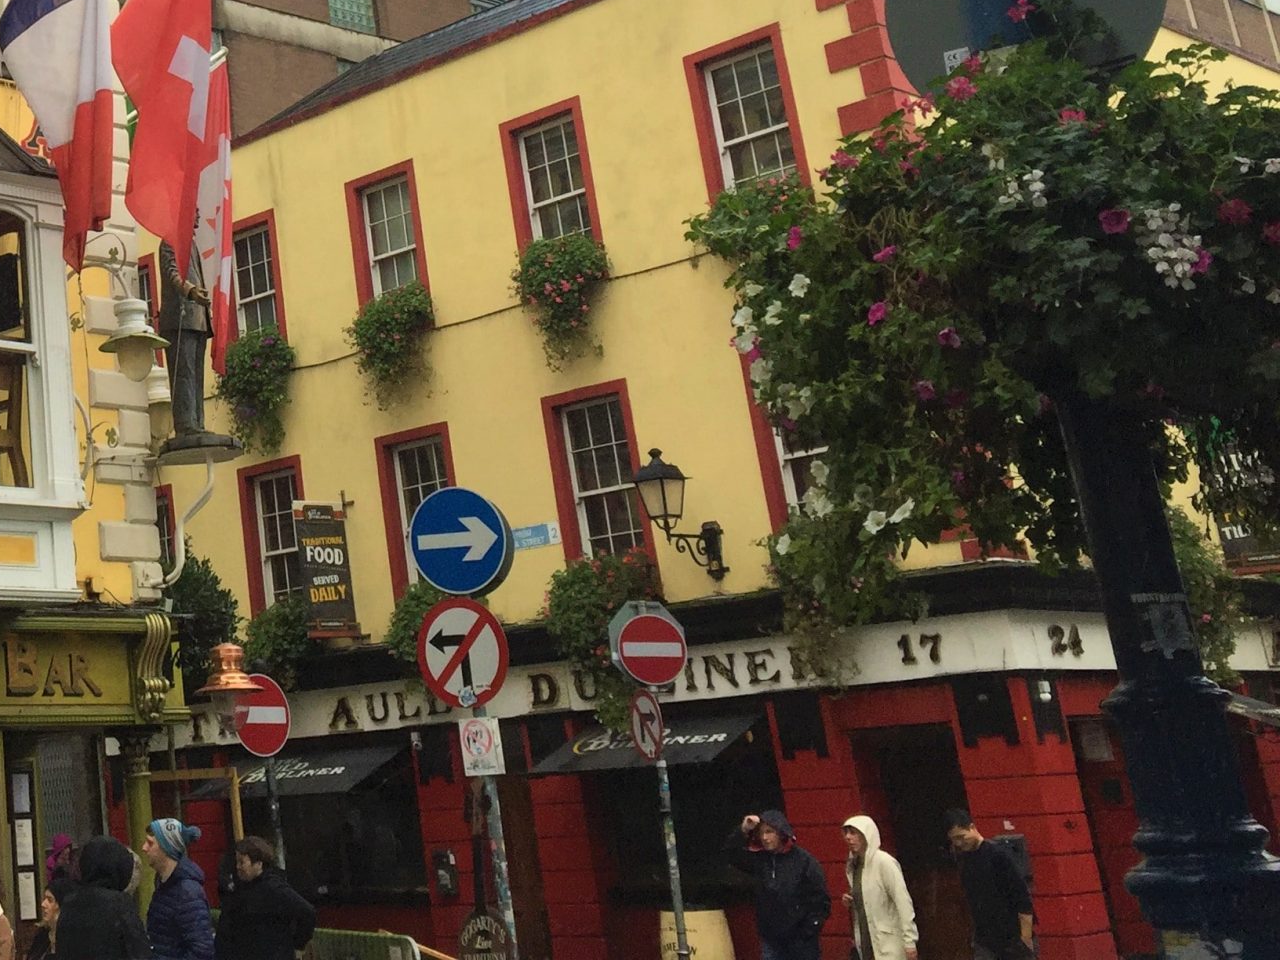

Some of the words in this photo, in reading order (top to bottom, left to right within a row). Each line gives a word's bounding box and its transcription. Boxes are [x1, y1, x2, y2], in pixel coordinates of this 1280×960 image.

[551, 527, 558, 539] 2
[306, 546, 344, 565] FOOD
[312, 574, 339, 586] SERVED
[310, 584, 347, 603] DAILY
[1047, 623, 1084, 658] 24
[3, 636, 104, 698] BAR
[527, 646, 824, 708] DUINER
[896, 632, 942, 666] 17
